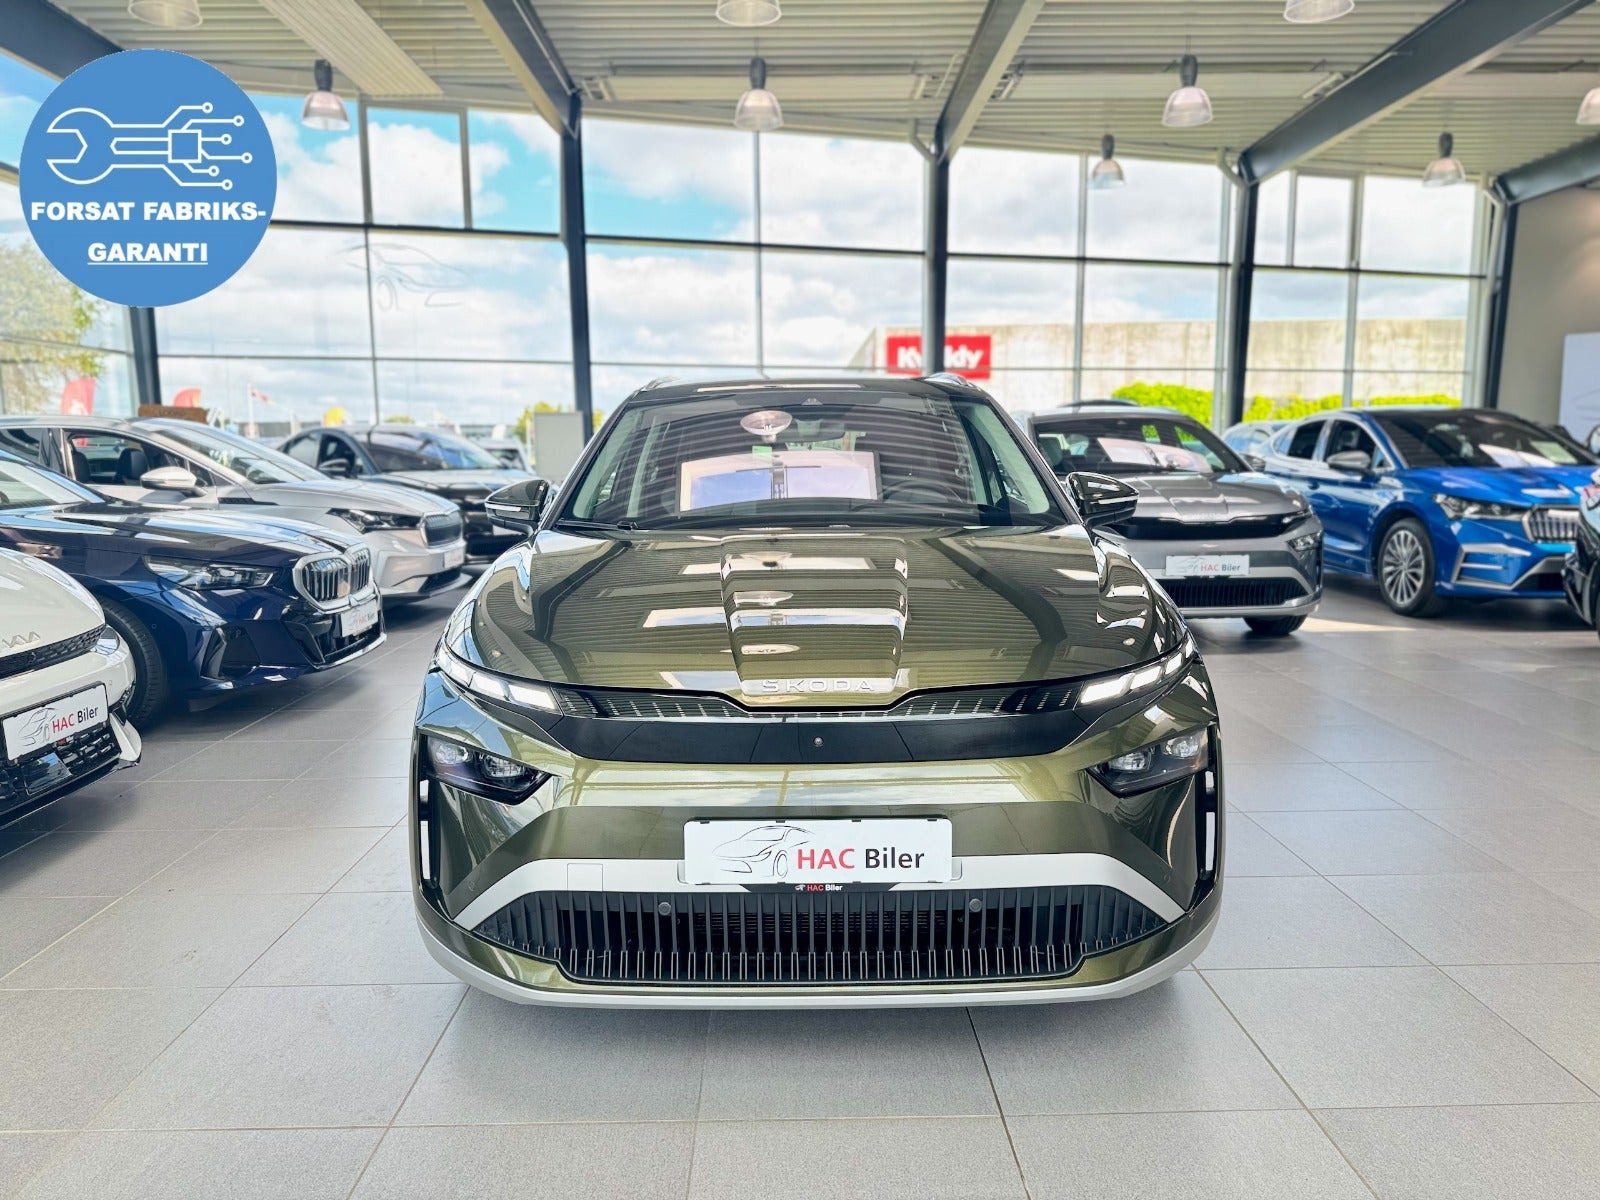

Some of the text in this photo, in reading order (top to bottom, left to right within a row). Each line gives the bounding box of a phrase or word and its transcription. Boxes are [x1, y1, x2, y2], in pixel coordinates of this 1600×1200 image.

[52, 706, 99, 733] HAC Biler
[797, 846, 925, 870] HAC Biler
